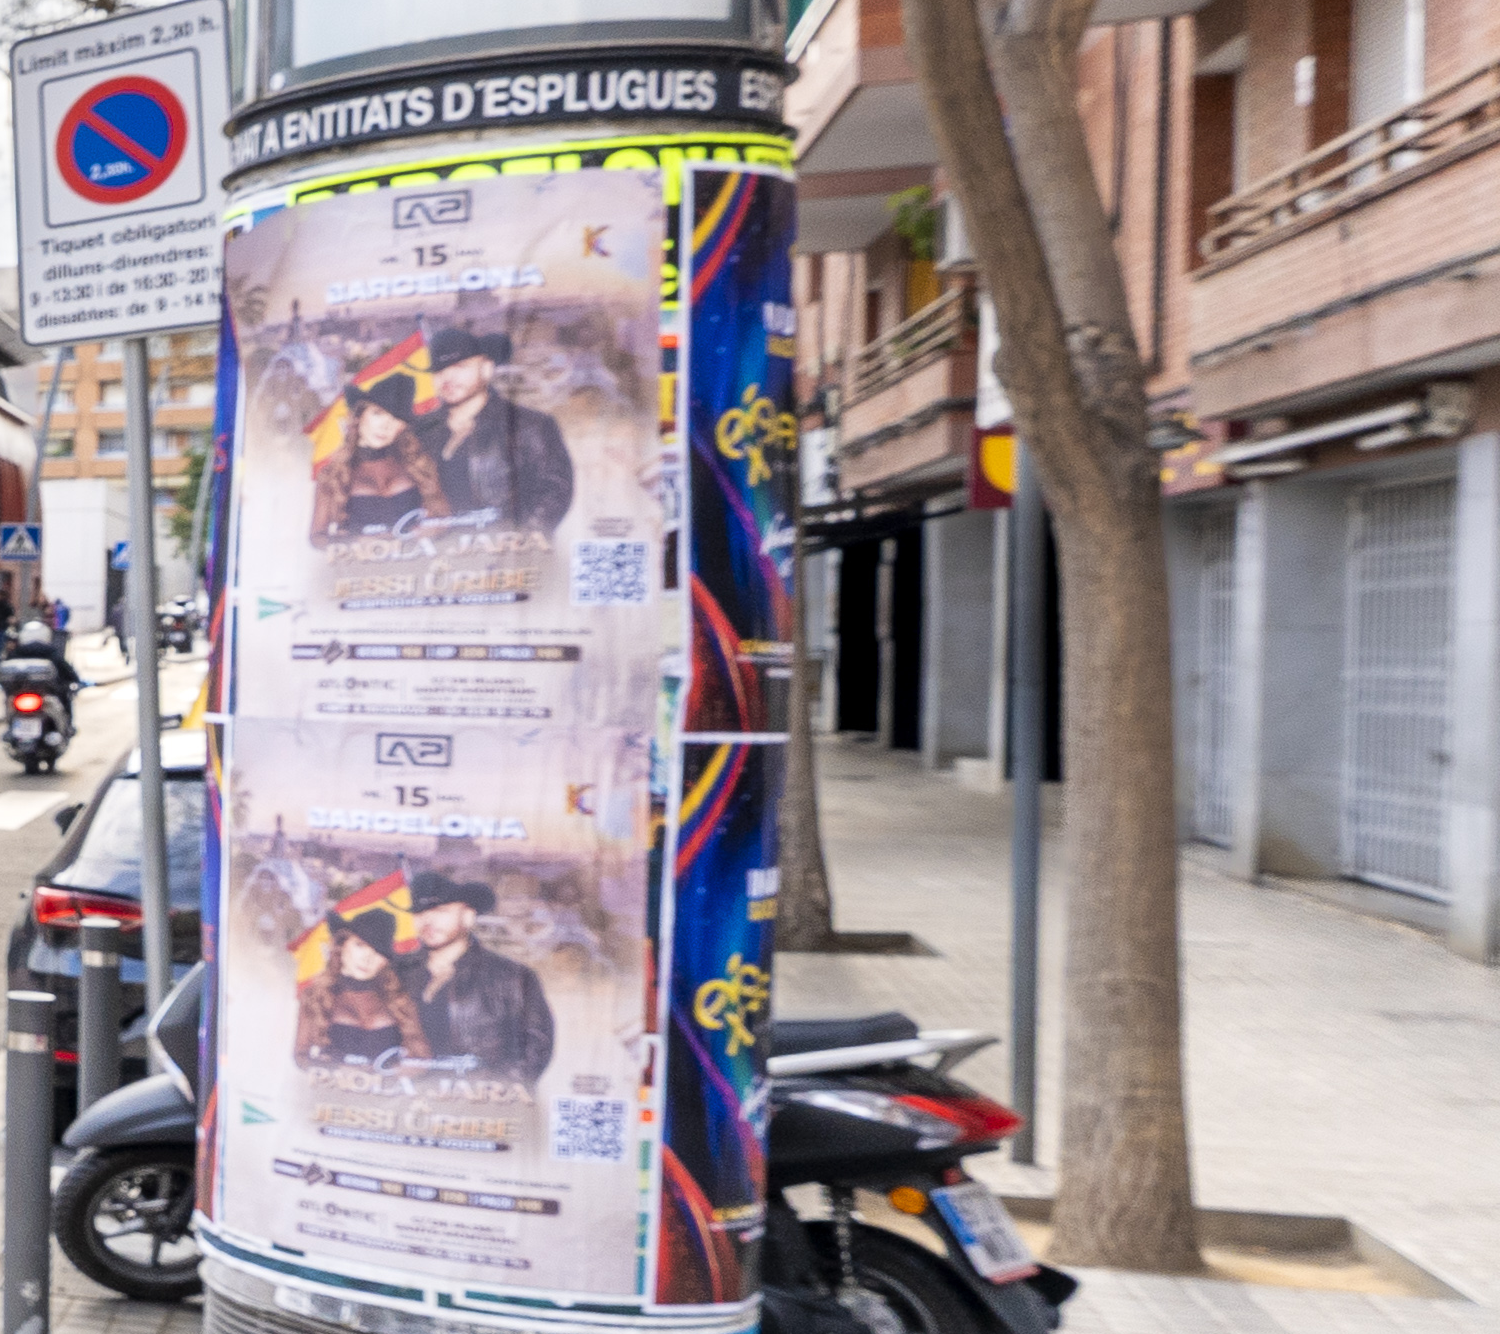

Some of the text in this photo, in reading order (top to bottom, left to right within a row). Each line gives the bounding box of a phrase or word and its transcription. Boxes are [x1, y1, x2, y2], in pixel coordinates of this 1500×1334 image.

[283, 86, 435, 149] ENTITATS
[40, 214, 217, 257] Tiquet obligatori
[414, 244, 447, 266] 15
[327, 265, 544, 304] BARCELONA
[327, 536, 437, 563] PAOLA
[394, 785, 429, 807] 15
[308, 807, 528, 839] BARCELONA
